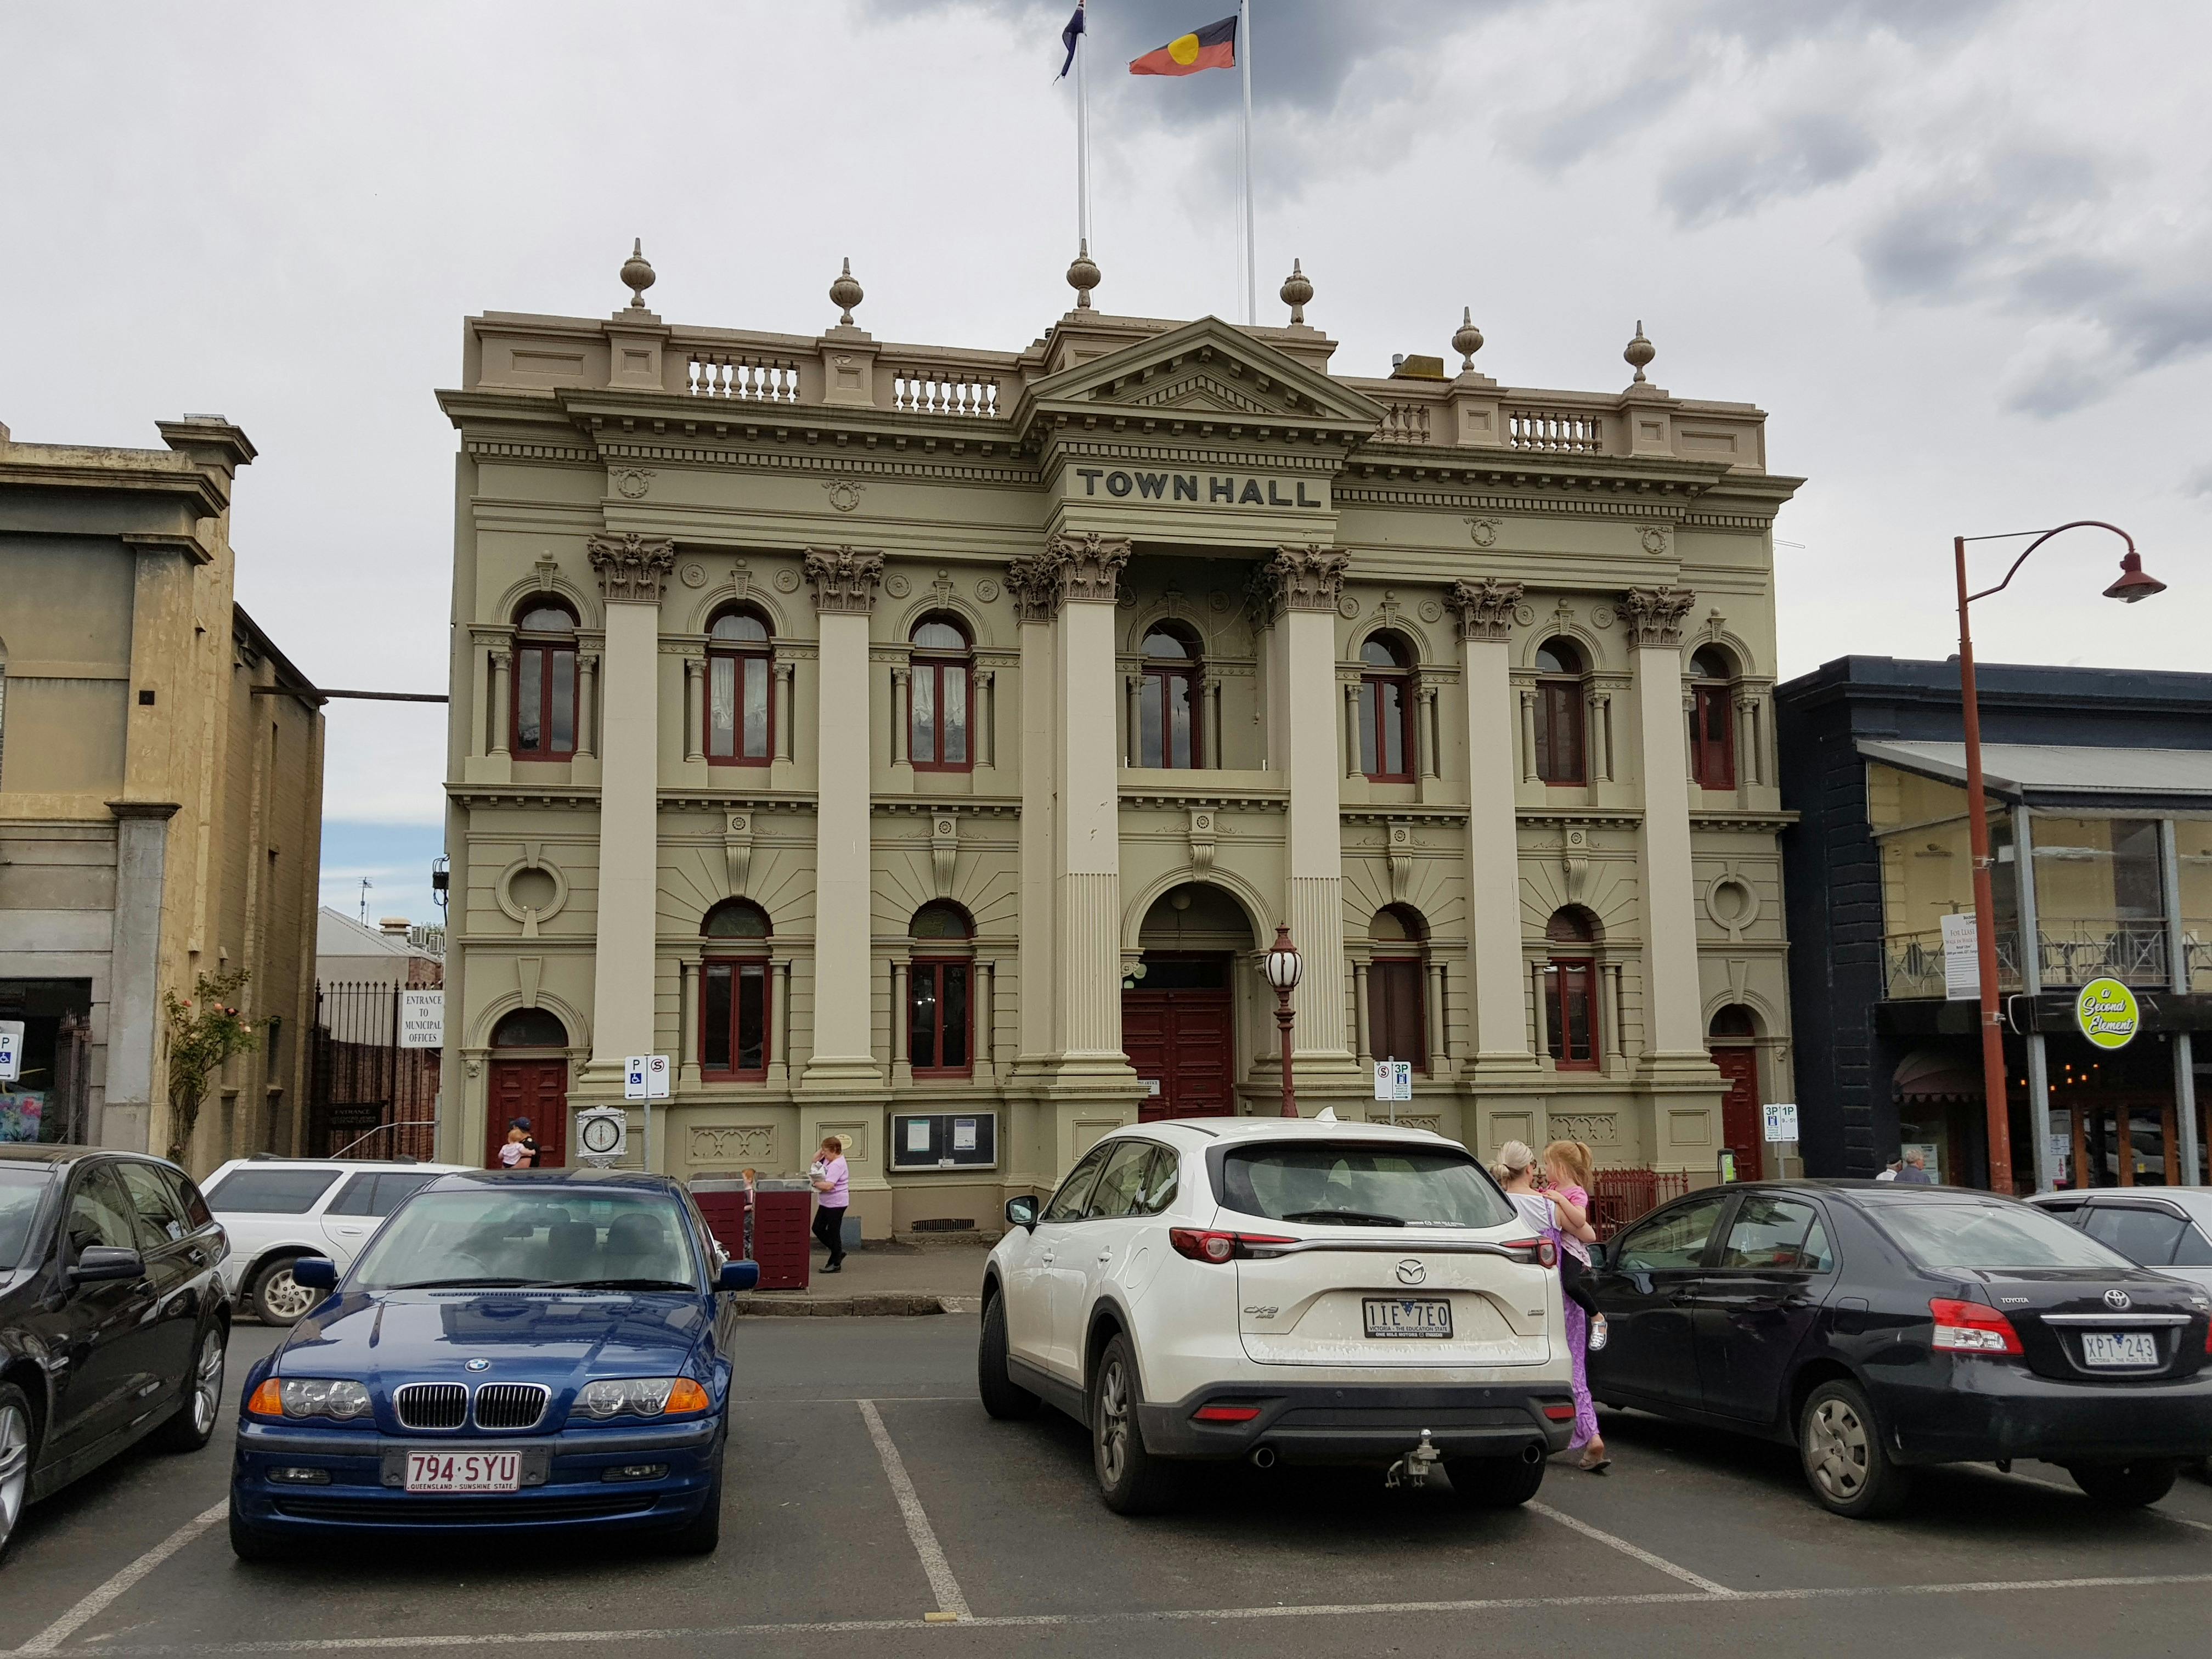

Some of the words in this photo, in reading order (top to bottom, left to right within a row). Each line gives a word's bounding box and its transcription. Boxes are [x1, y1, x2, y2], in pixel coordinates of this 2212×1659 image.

[1076, 469, 1198, 501] TOWN
[1210, 476, 1321, 507] HALL
[407, 996, 442, 1005] ENTRANCE
[2083, 996, 2126, 1017] Second
[419, 1008, 428, 1017] TO
[405, 1020, 442, 1030] MUNICIPAL
[2088, 1015, 2134, 1035] Element
[409, 1034, 437, 1042] OFFICES
[2, 1037, 10, 1049] P
[633, 1059, 640, 1070] P
[1395, 1064, 1408, 1073] 3P
[1766, 1107, 1778, 1115] 3P
[1782, 1107, 1794, 1115] 1P
[1243, 1305, 1279, 1313] CX-9
